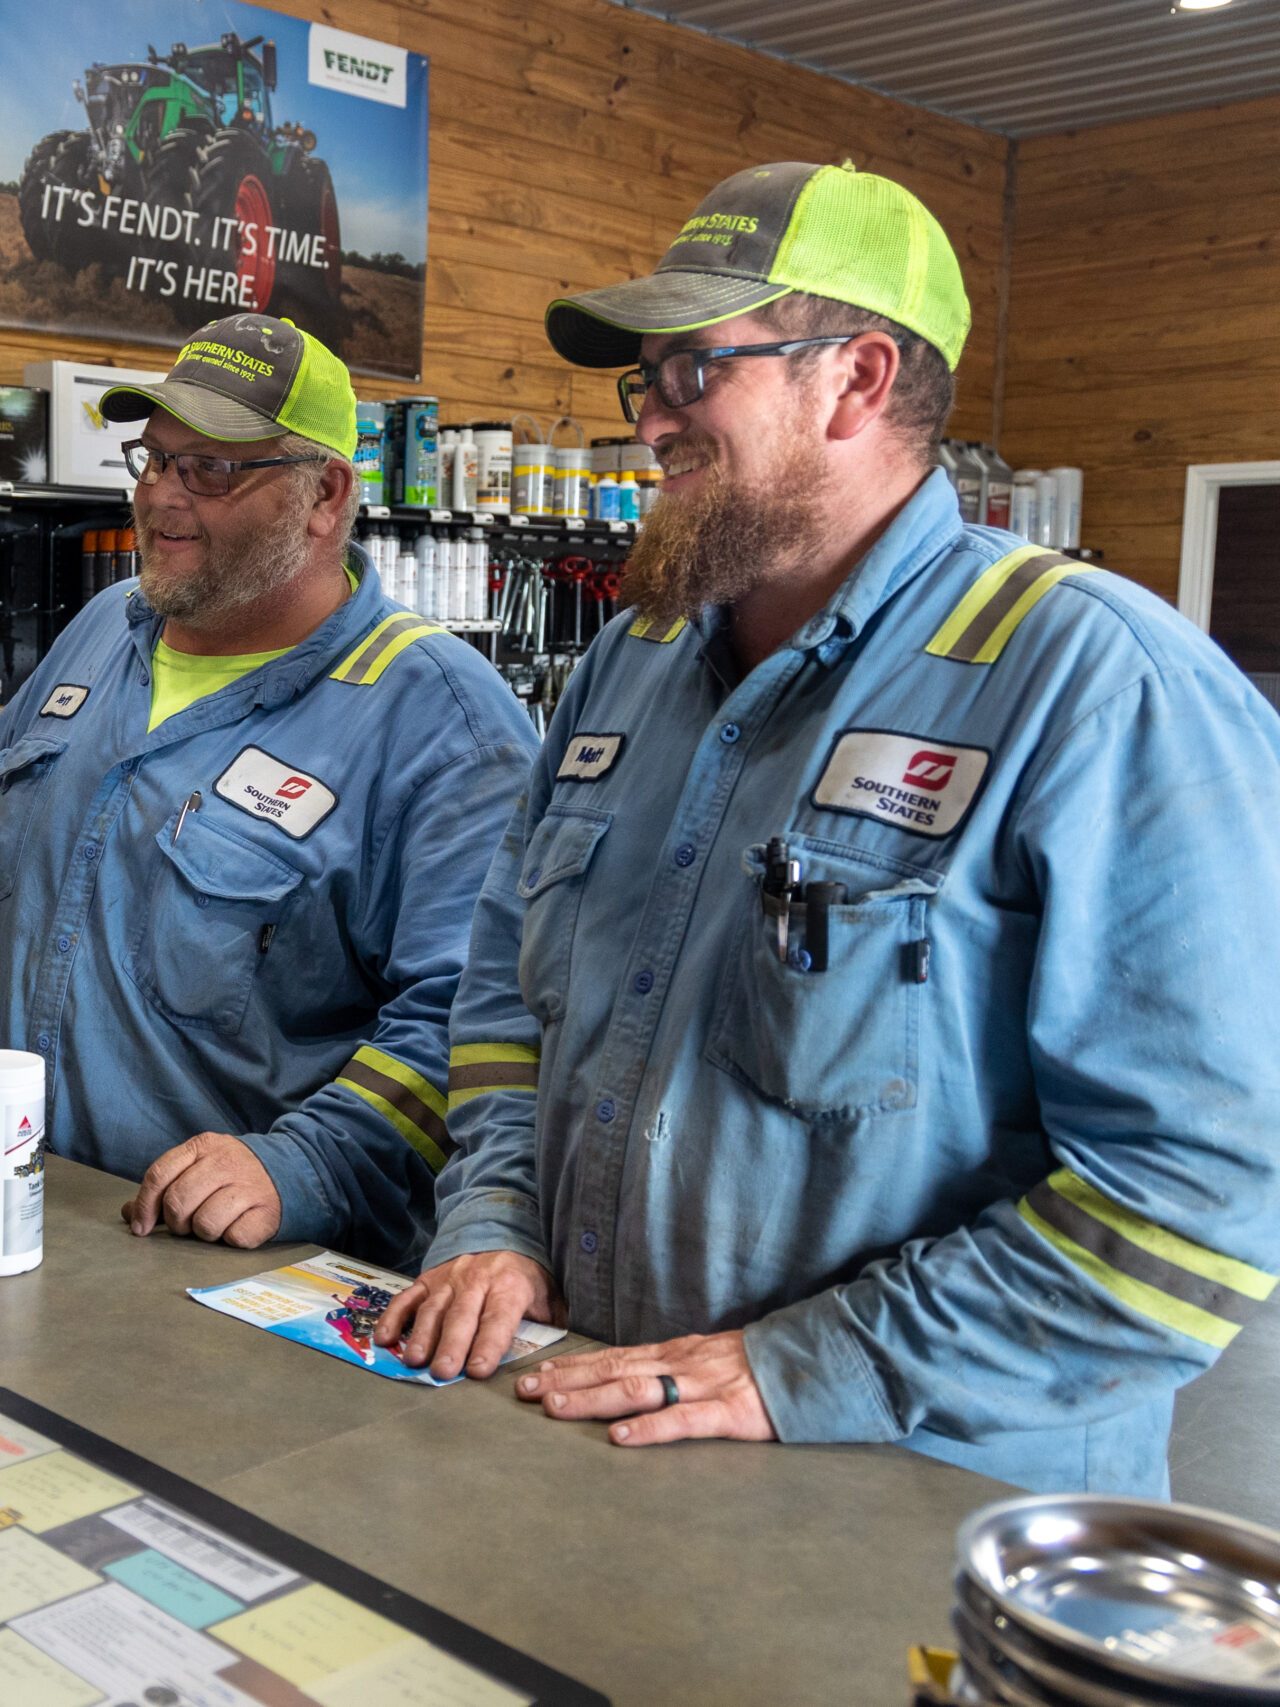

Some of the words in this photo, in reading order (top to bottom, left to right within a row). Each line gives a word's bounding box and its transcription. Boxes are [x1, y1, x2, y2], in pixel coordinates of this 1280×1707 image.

[323, 48, 394, 84] FENDT
[41, 184, 96, 227] IT'S
[102, 196, 202, 246] FENDT.
[211, 216, 259, 255] IT'S
[264, 226, 330, 269] TIME.
[705, 213, 759, 233] STATES
[126, 256, 179, 296] IT'S
[182, 265, 259, 309] HERE.
[190, 341, 235, 360] SOUTHERN
[232, 350, 275, 377] STATES
[575, 745, 606, 764] Matt
[243, 784, 292, 812] SOUTHERN
[253, 801, 285, 818] STATES
[850, 776, 942, 812] SOUTHERN
[875, 796, 936, 827] STATES
